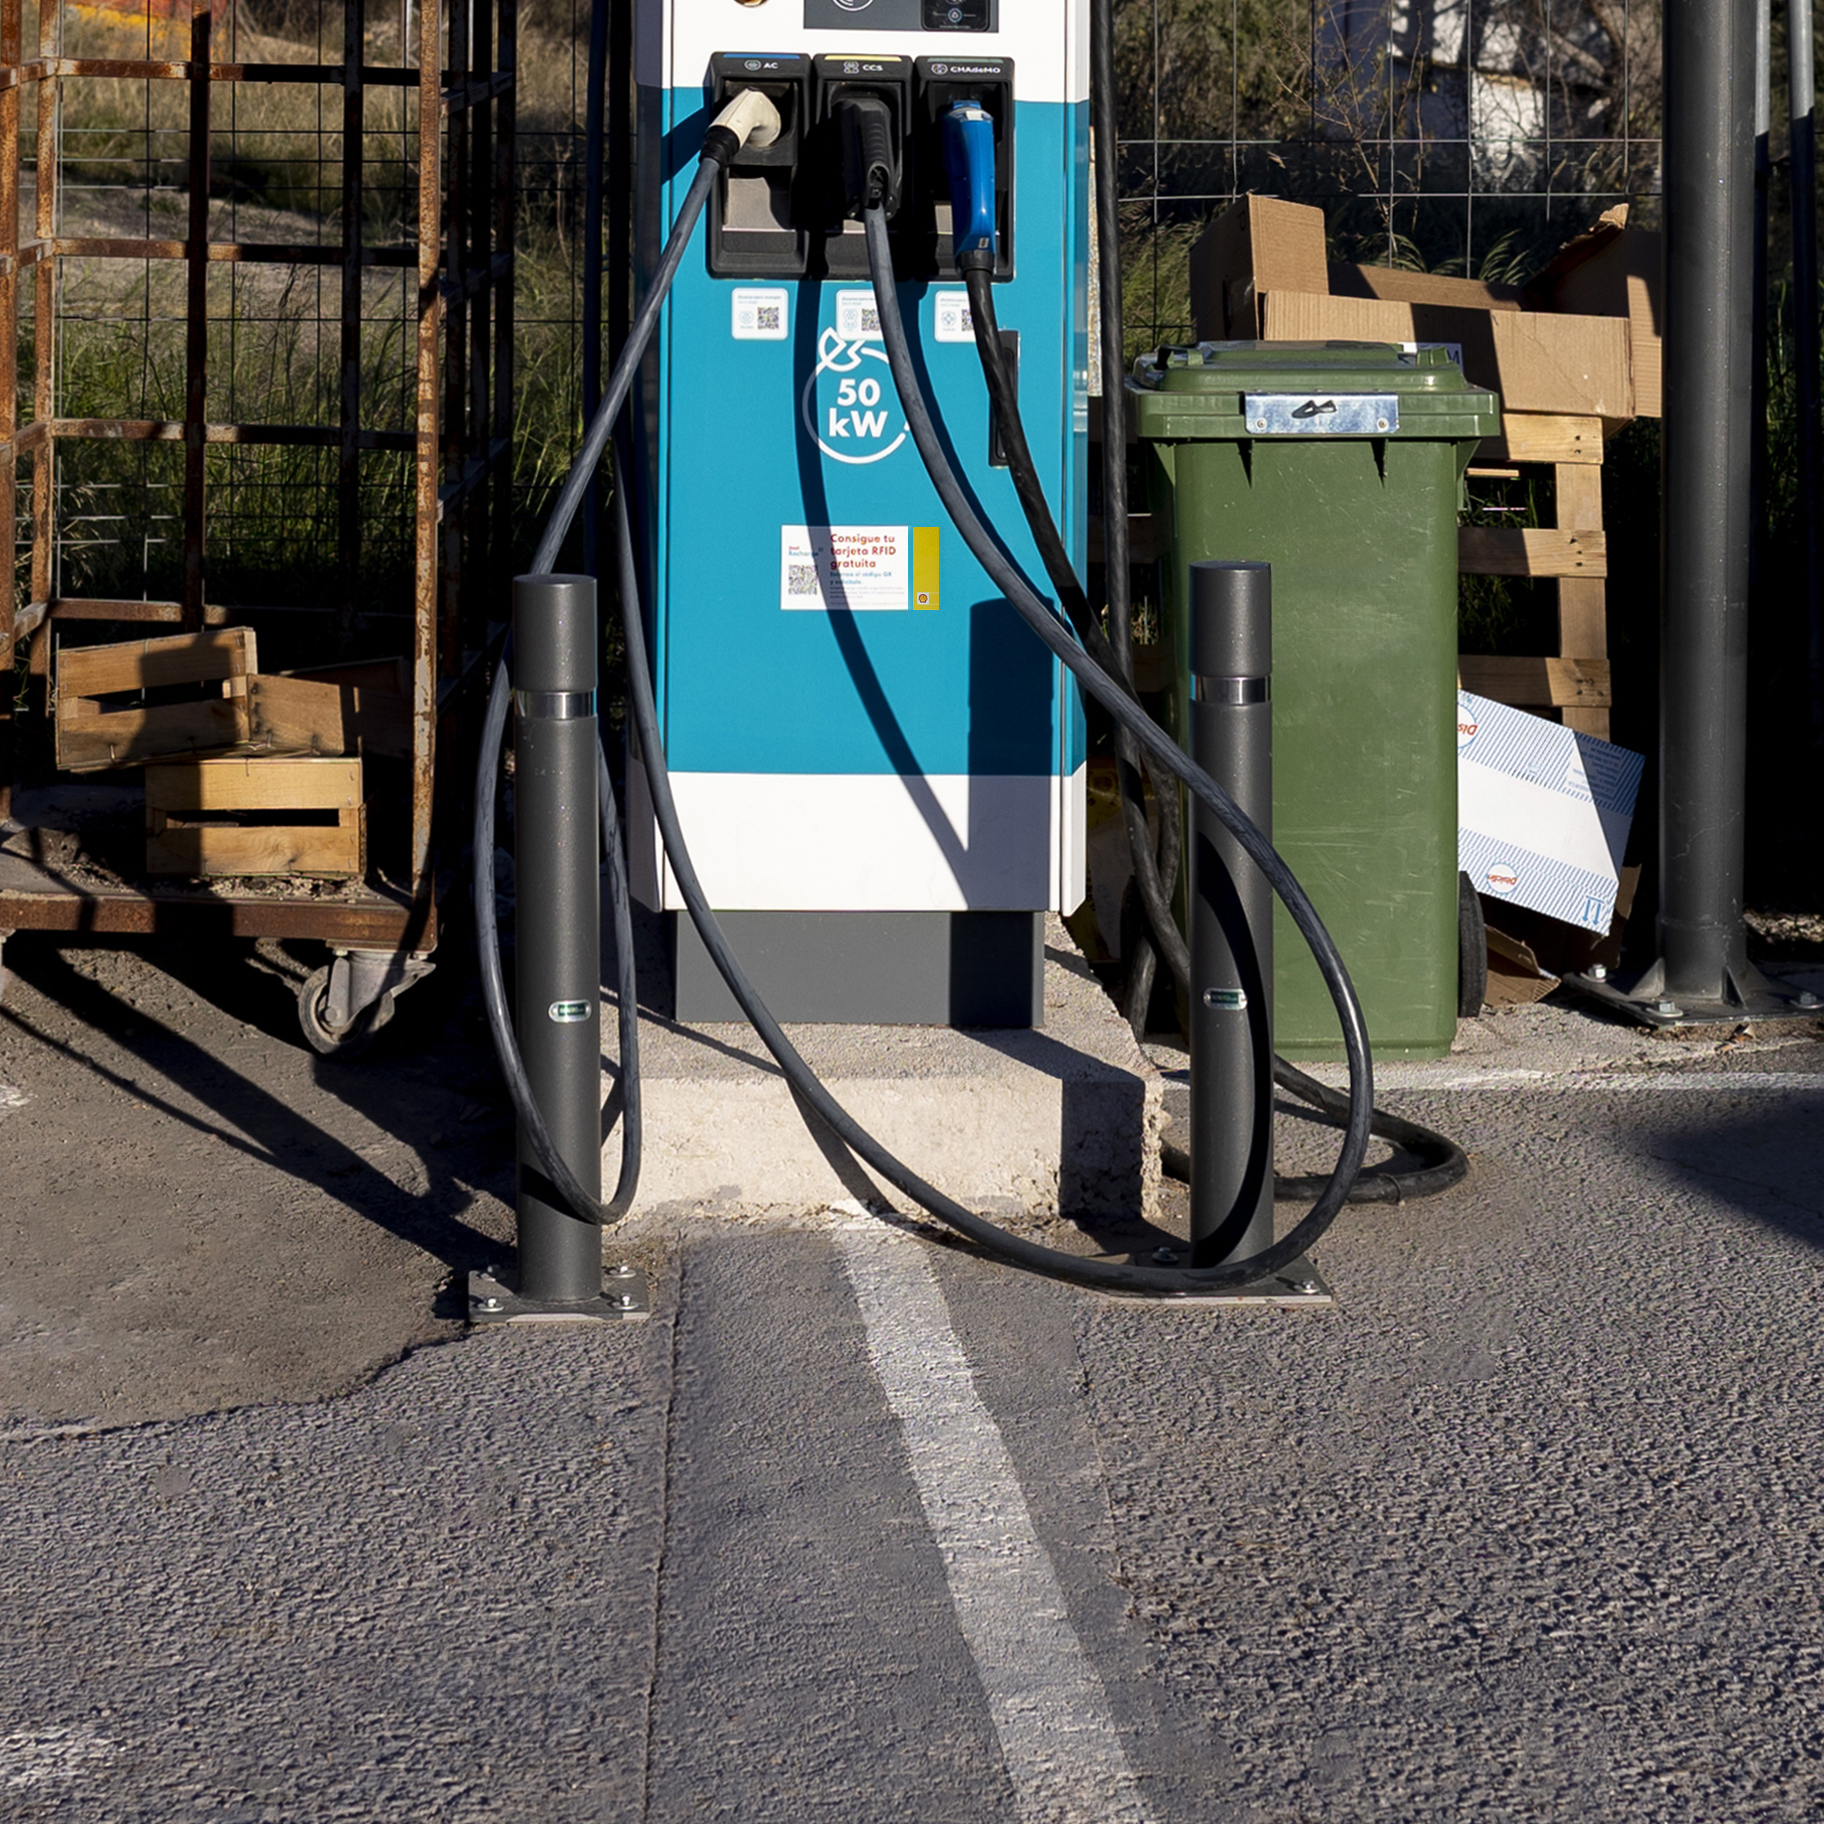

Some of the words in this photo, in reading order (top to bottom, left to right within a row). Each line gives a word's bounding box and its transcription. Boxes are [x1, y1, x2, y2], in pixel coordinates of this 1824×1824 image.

[950, 66, 1001, 74] CHAdeMO
[837, 378, 881, 407] 50
[829, 407, 889, 438] kW
[830, 533, 881, 545] Consigue
[883, 535, 895, 543] tu
[788, 550, 819, 558] Recharge
[830, 546, 868, 558] tarjeta
[871, 546, 896, 555] RFID
[830, 559, 876, 570] gratuita
